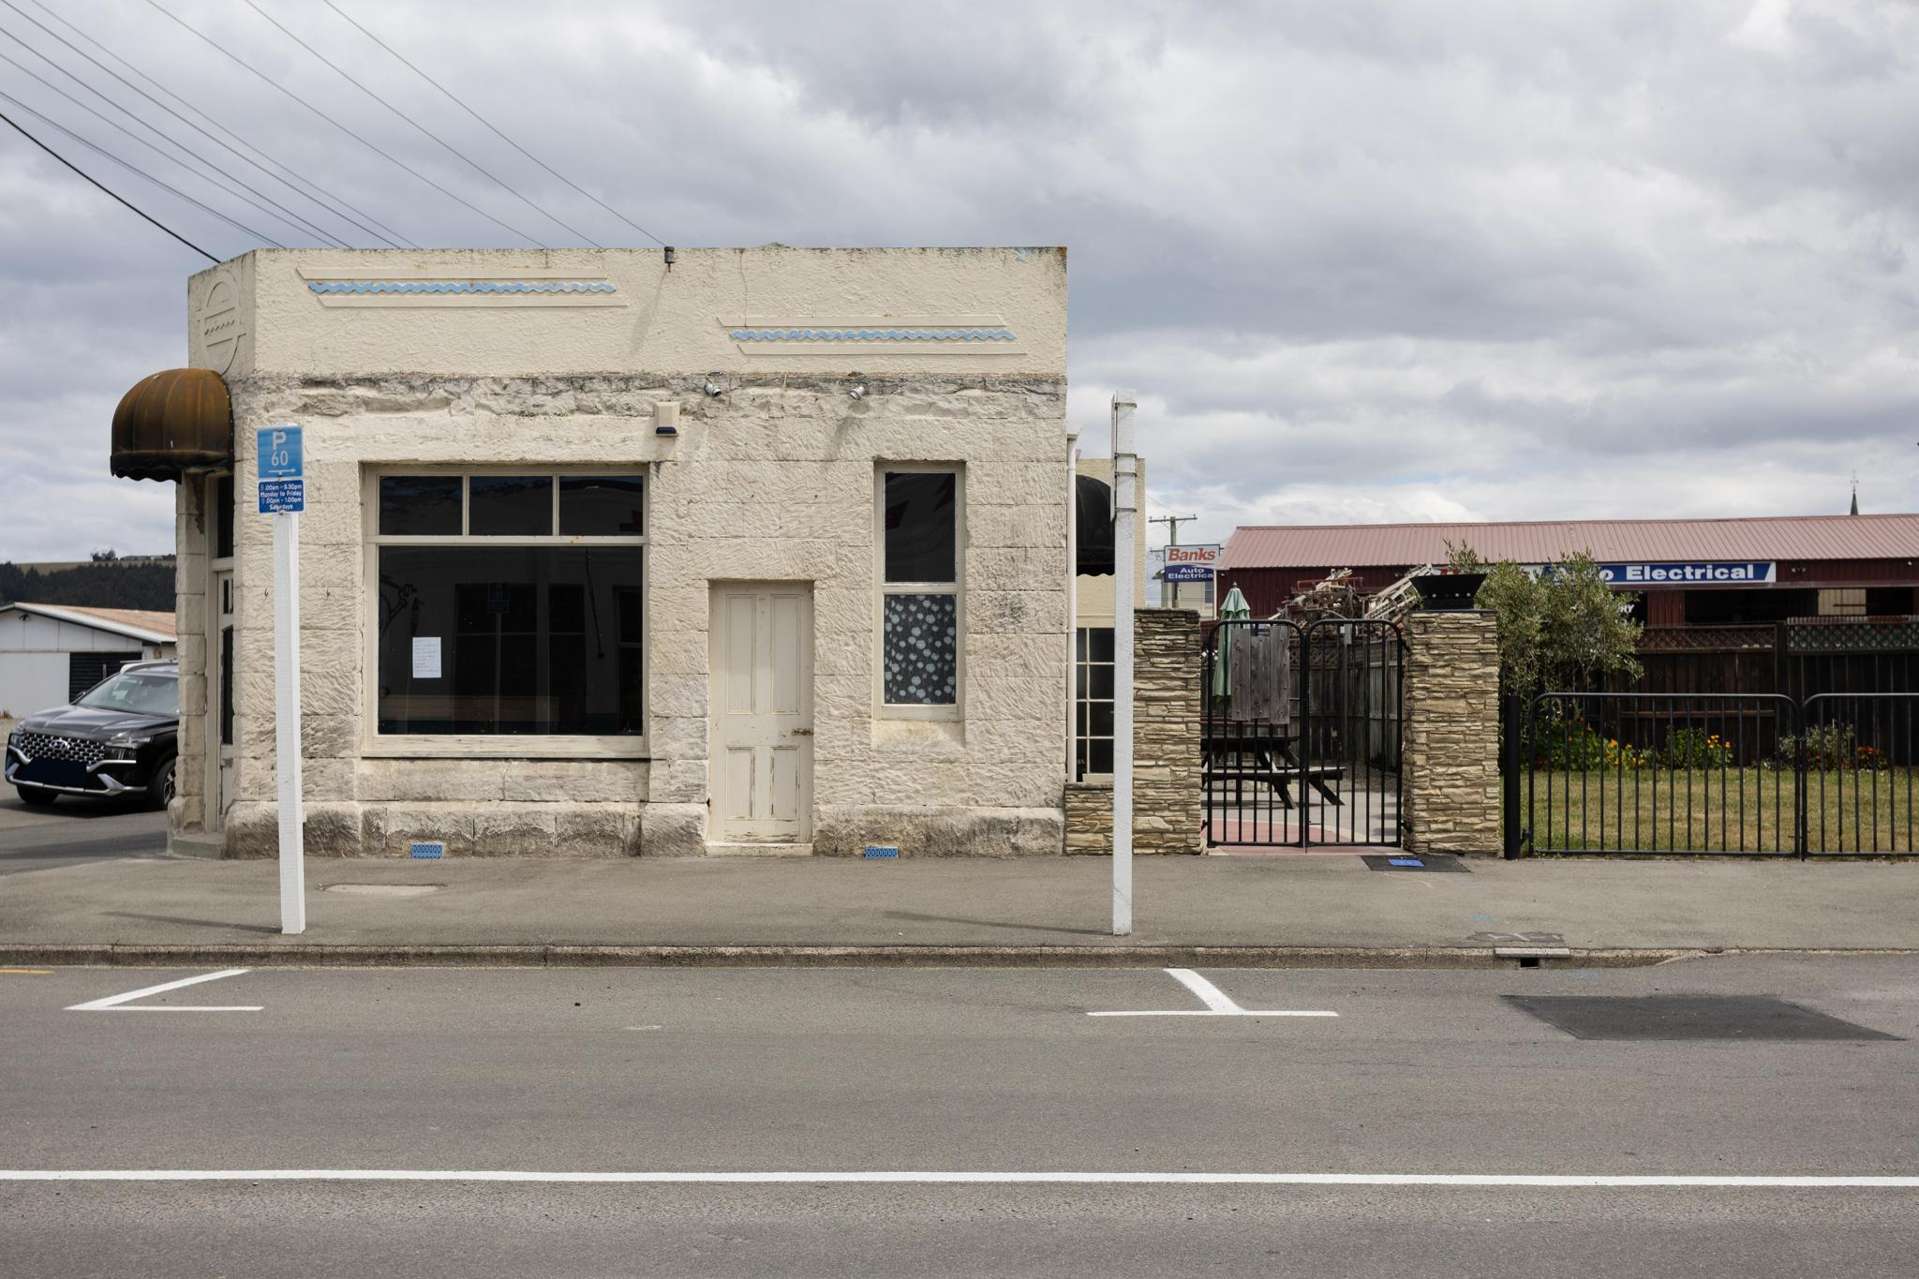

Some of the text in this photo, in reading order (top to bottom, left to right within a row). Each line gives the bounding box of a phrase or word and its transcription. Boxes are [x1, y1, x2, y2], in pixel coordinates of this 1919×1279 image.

[272, 431, 287, 450] P
[271, 450, 288, 466] 60
[1168, 548, 1216, 561] Banks
[1626, 564, 1754, 580] Electrical
